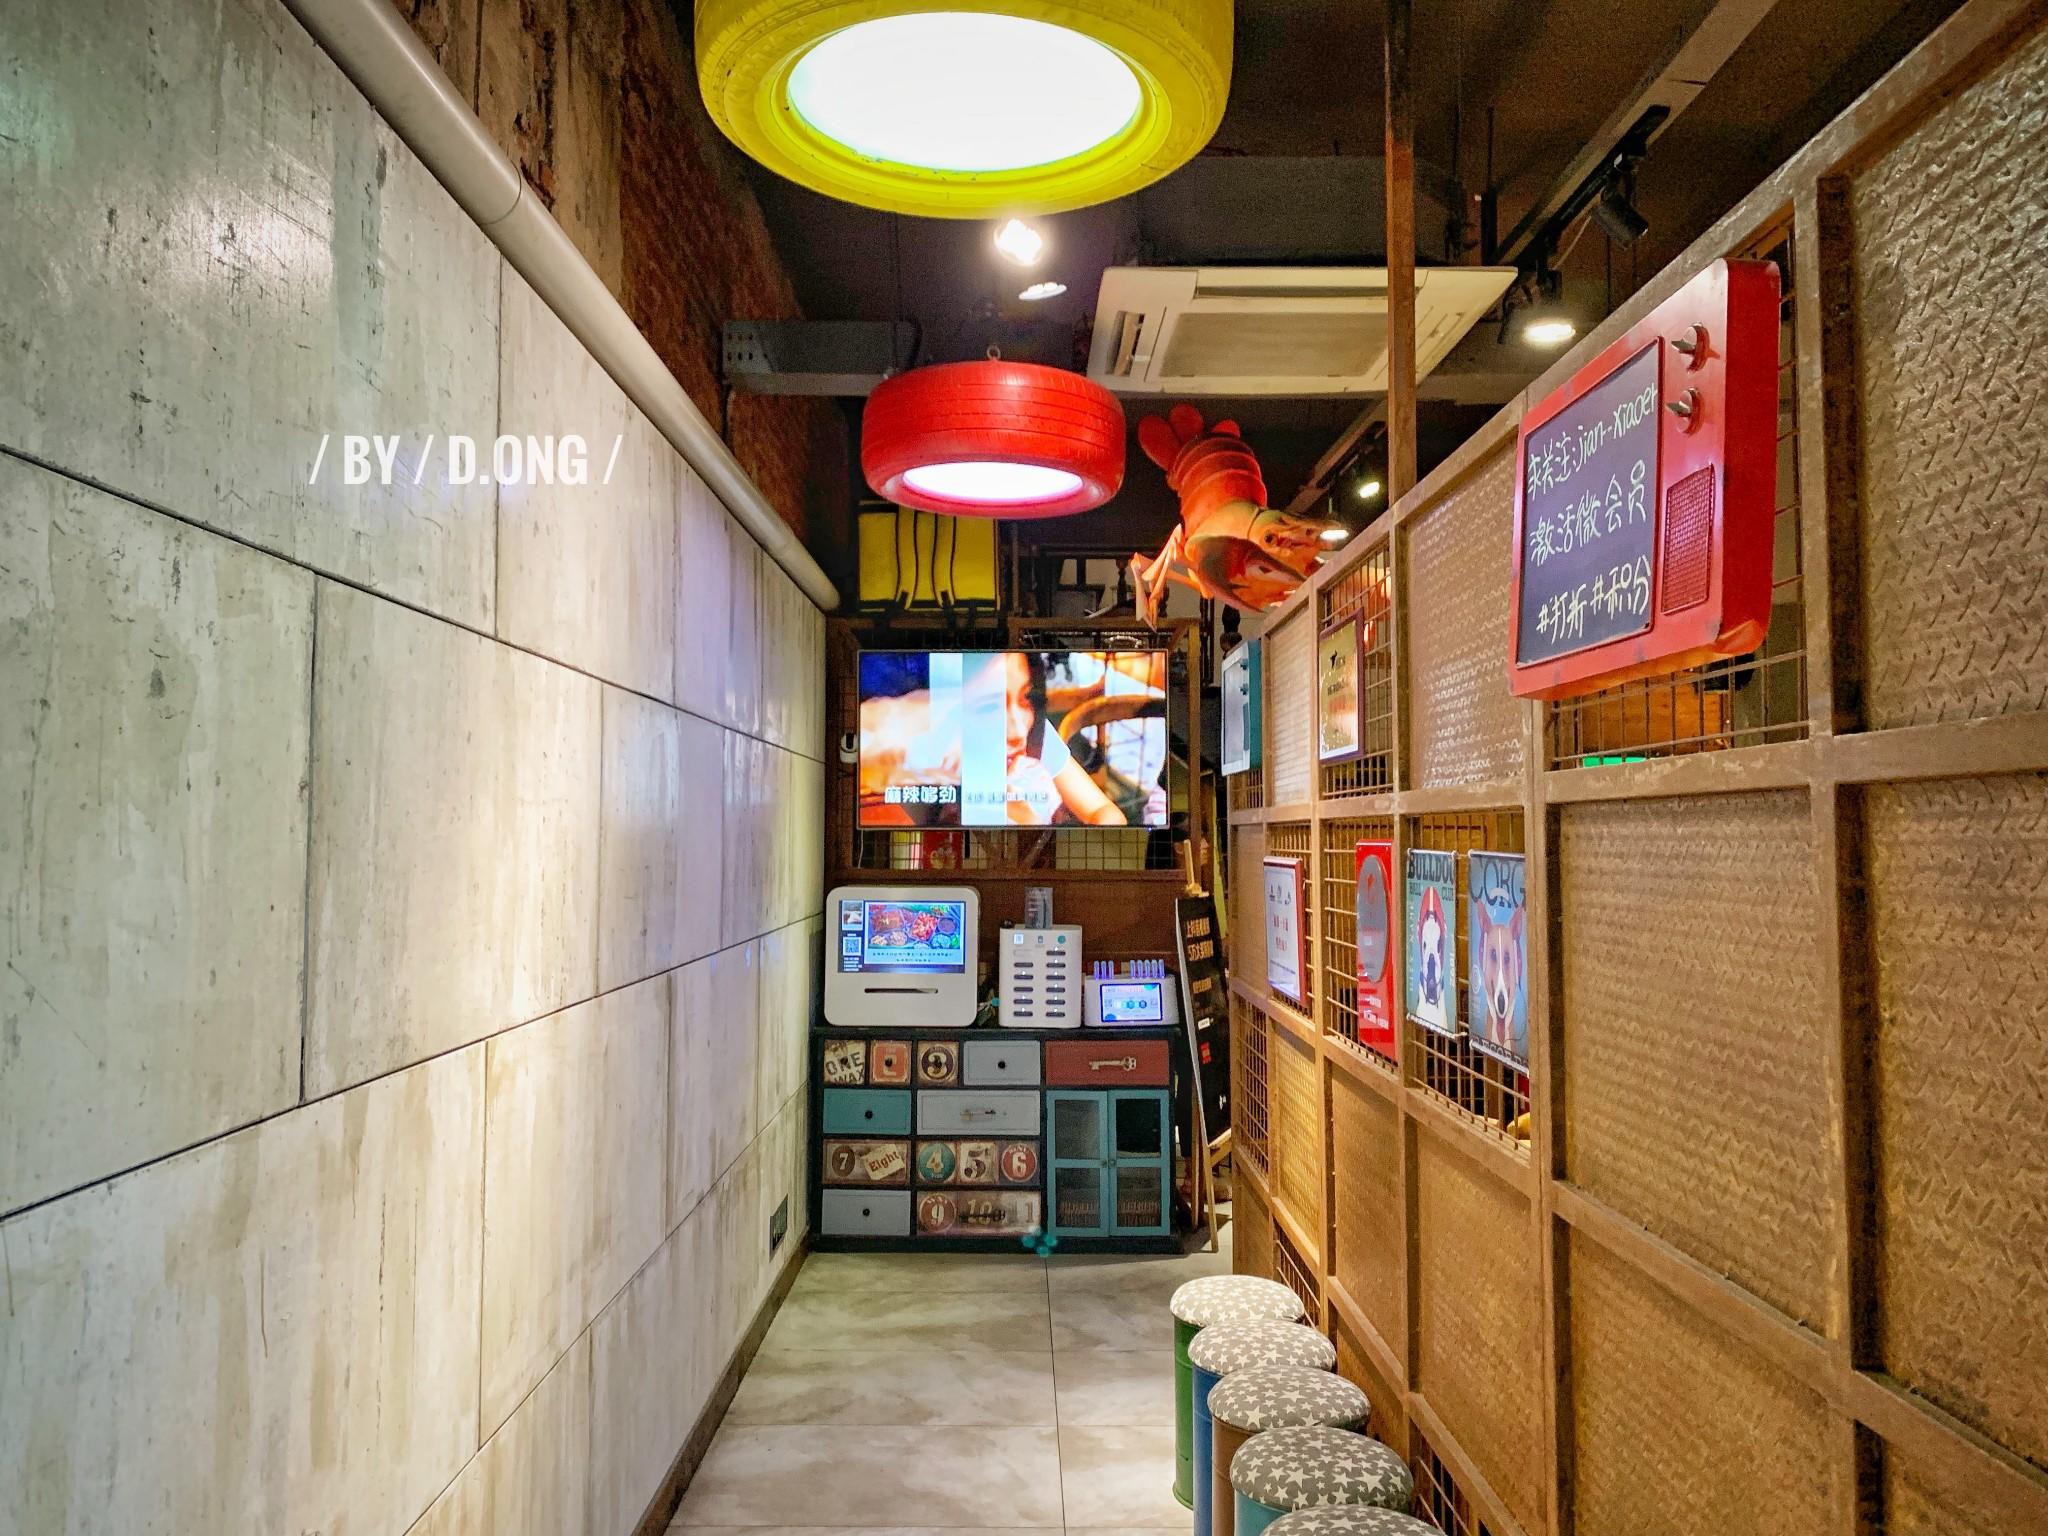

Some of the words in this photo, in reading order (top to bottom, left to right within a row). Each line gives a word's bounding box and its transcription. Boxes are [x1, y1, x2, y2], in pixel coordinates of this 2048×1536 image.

[1530, 459, 1647, 567] 激活微会员
[825, 1052, 864, 1076] ONE
[927, 1052, 948, 1078] 3
[839, 1152, 849, 1170] 7
[868, 1151, 900, 1173] Eight
[926, 1151, 945, 1174] 4
[964, 1147, 989, 1179] 5
[1012, 1151, 1027, 1178] 6
[931, 1203, 945, 1225] 9
